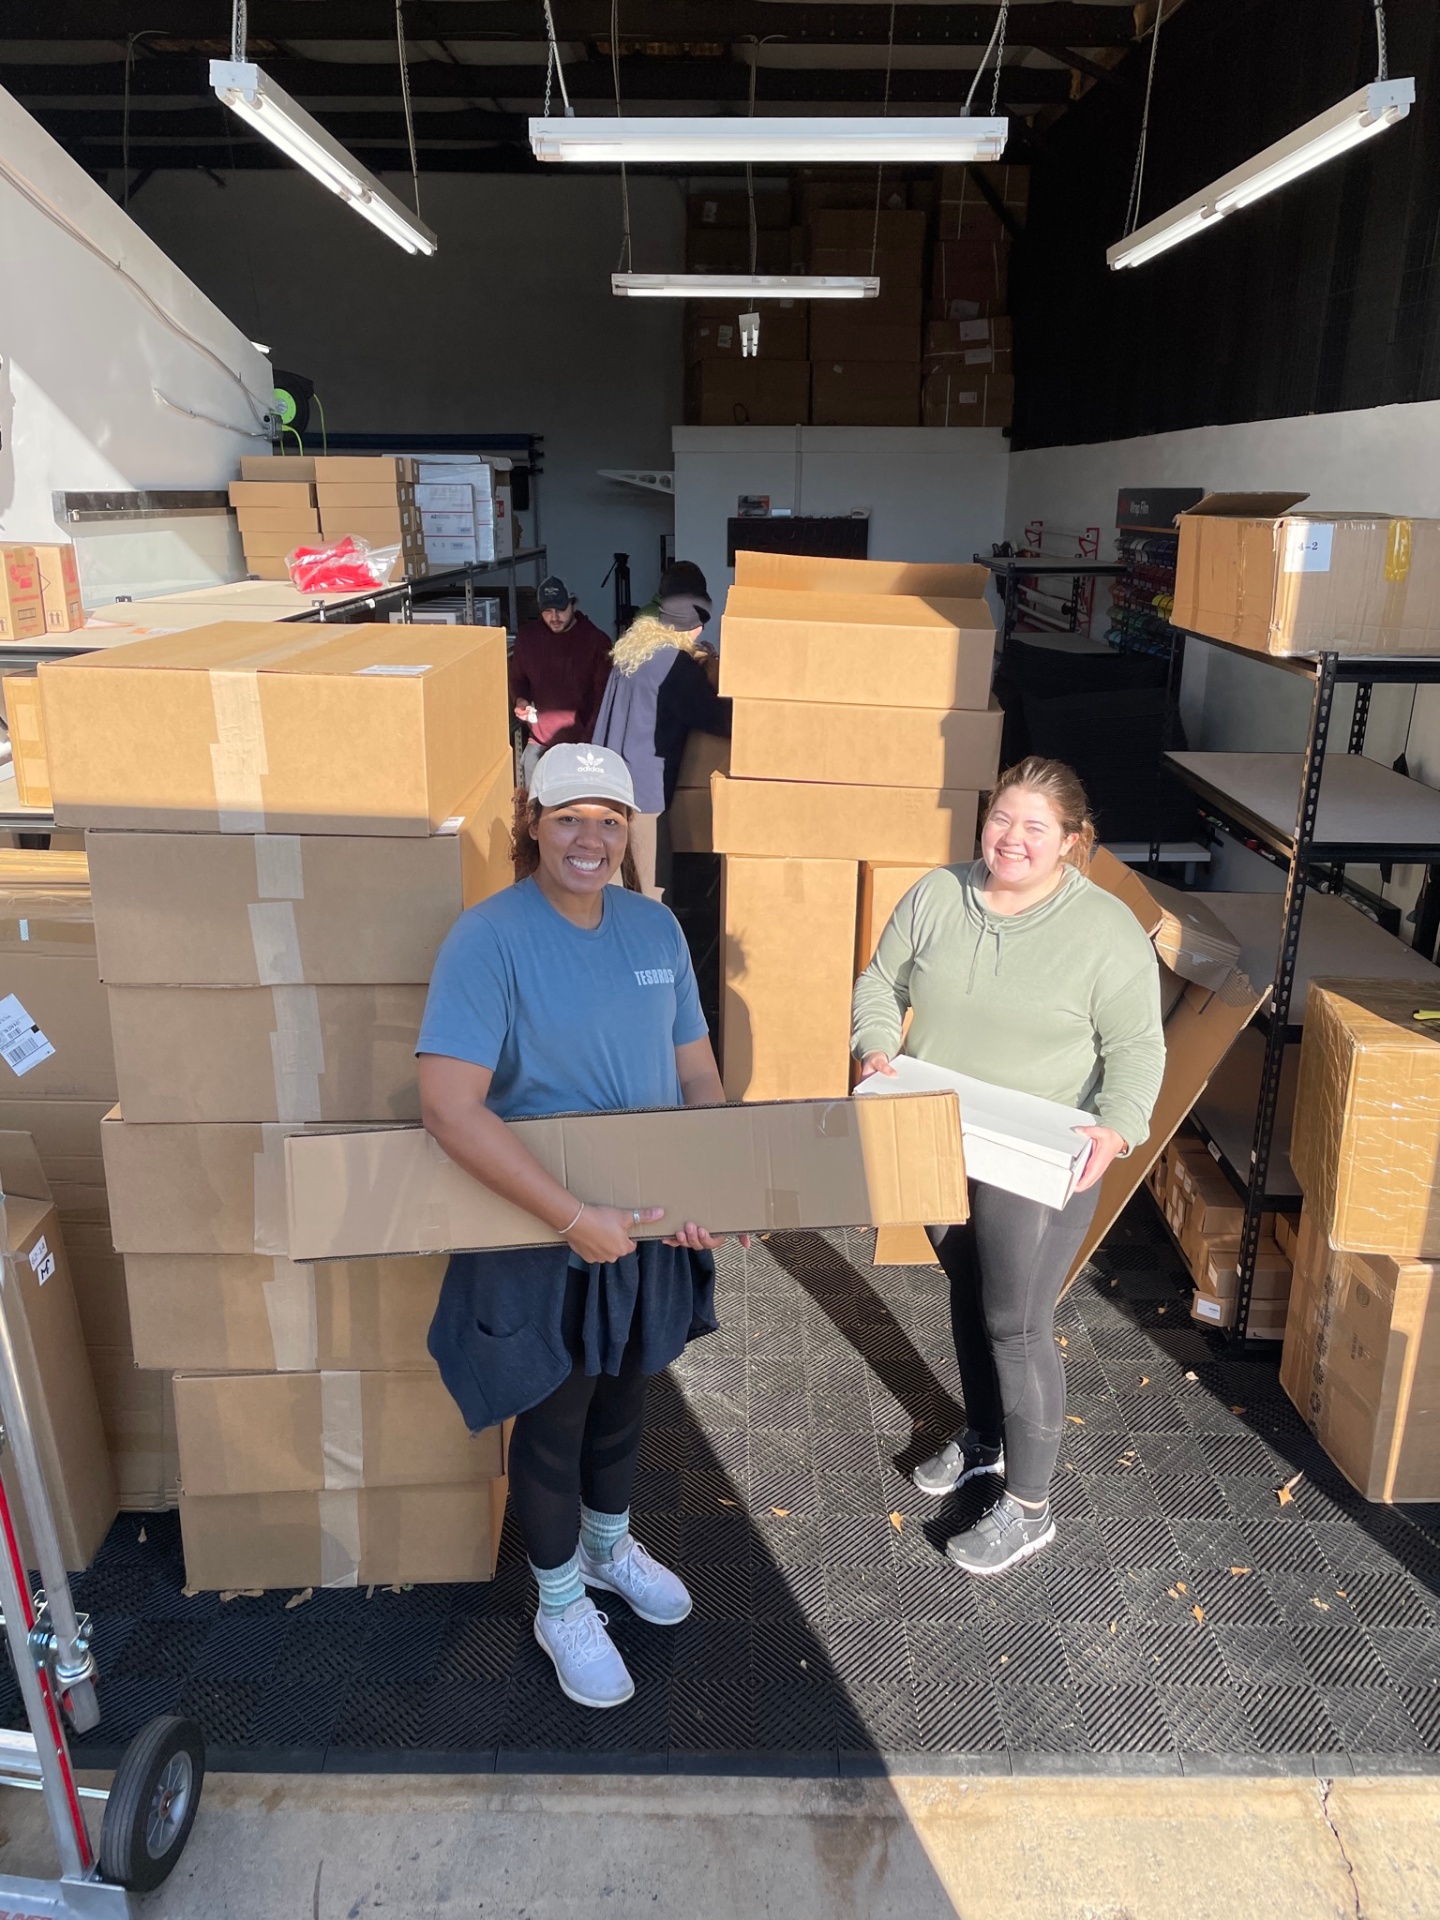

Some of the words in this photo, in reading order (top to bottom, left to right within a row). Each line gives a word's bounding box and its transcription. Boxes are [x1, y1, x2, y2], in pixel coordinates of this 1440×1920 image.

[1298, 541, 1318, 551] 4-2
[577, 765, 605, 774] adidas
[634, 968, 675, 986] TESBROS
